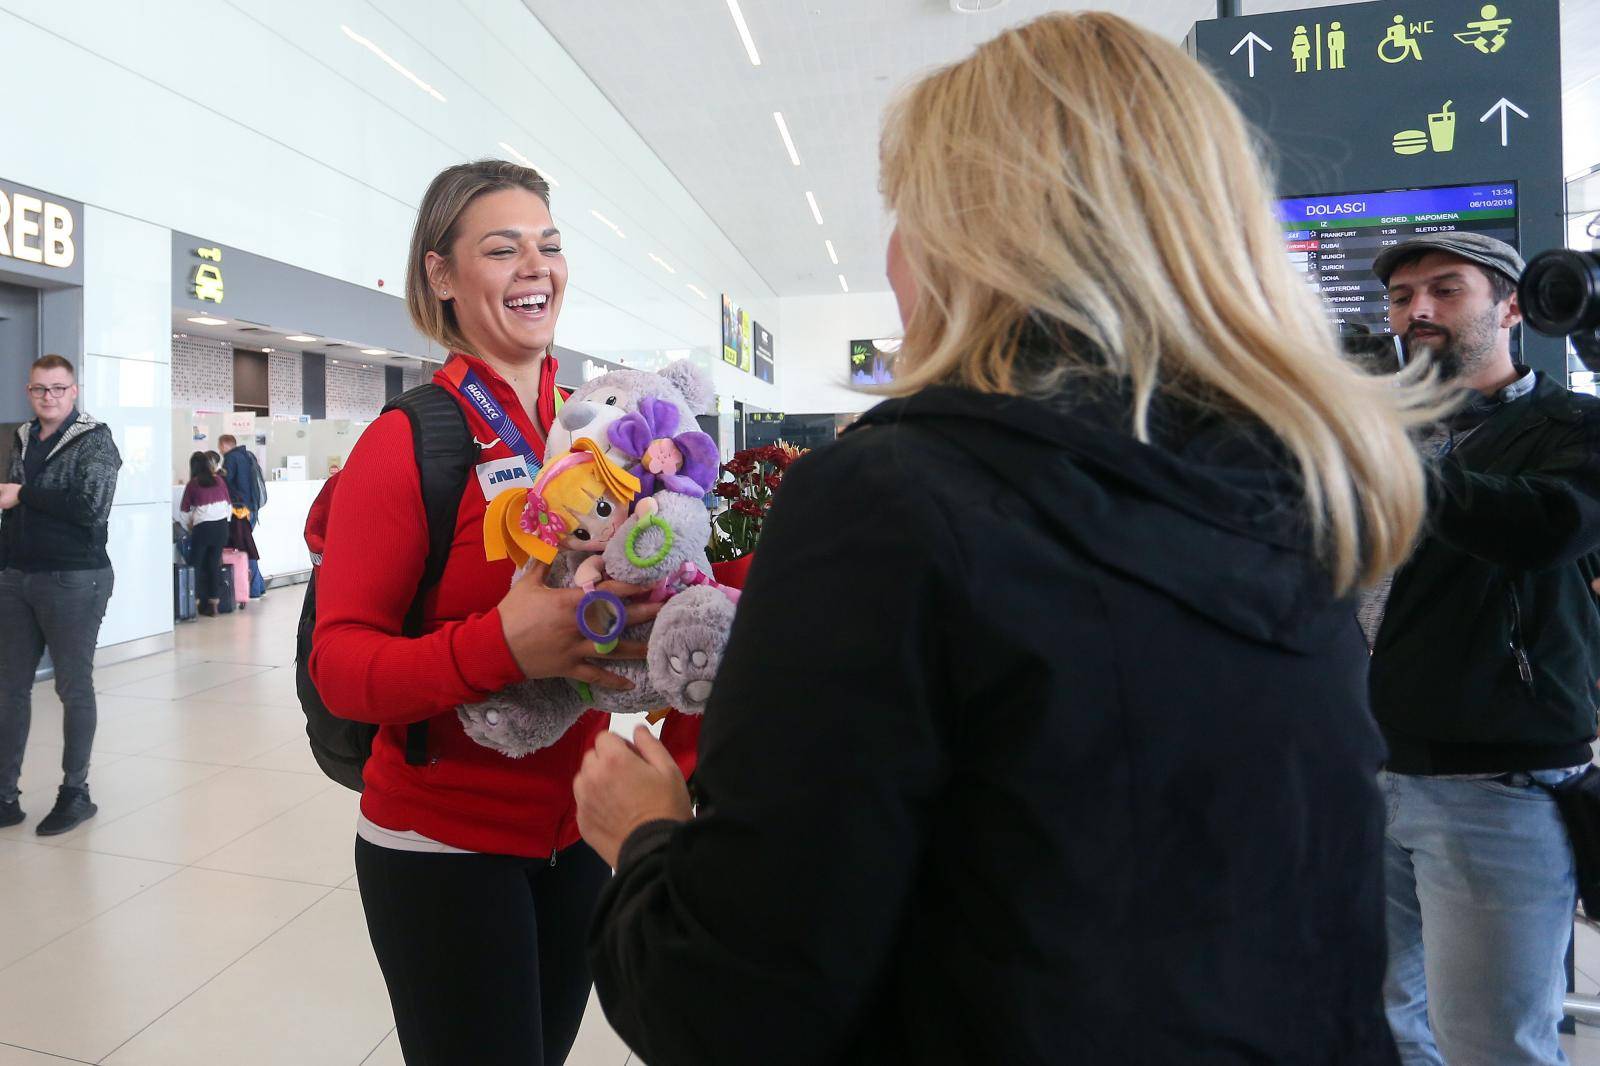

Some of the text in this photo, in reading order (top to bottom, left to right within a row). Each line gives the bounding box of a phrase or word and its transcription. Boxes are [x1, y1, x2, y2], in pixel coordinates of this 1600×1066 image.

[1409, 20, 1434, 34] WC
[1490, 187, 1513, 197] 13:34
[1306, 202, 1366, 216] DOLASCI
[1380, 216, 1408, 224] SCHED.
[1414, 212, 1459, 222] NAPOMENA
[1320, 231, 1357, 239] FRANKFURT
